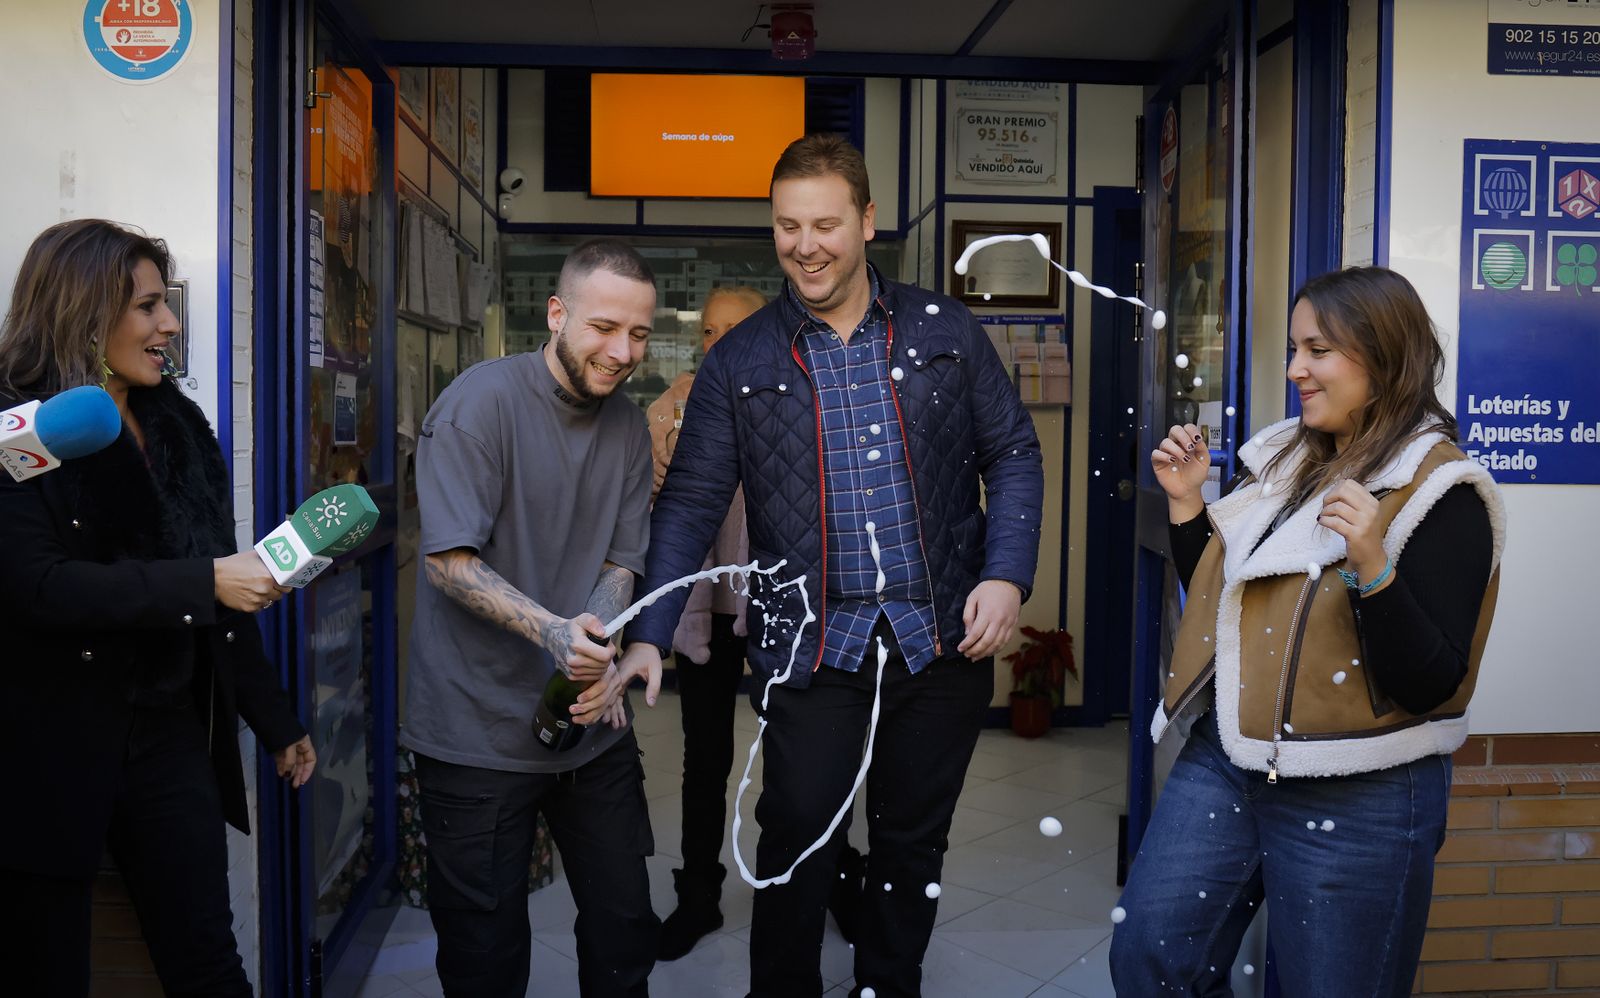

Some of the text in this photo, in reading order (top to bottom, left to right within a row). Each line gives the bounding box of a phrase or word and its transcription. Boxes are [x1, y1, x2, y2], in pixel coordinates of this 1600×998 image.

[118, 0, 161, 17] +18
[1505, 29, 1600, 45] 902 15 15 20
[1504, 49, 1600, 63] www.segur24.es
[967, 115, 1046, 127] GRAN PREMIO
[662, 132, 734, 143] Semana de aúpa
[969, 163, 1043, 174] VENDIDO AQUÍ
[1467, 394, 1571, 420] Loterías y
[1467, 422, 1600, 447] Apuestas del
[1467, 449, 1538, 470] Estado
[270, 541, 293, 565] AD
